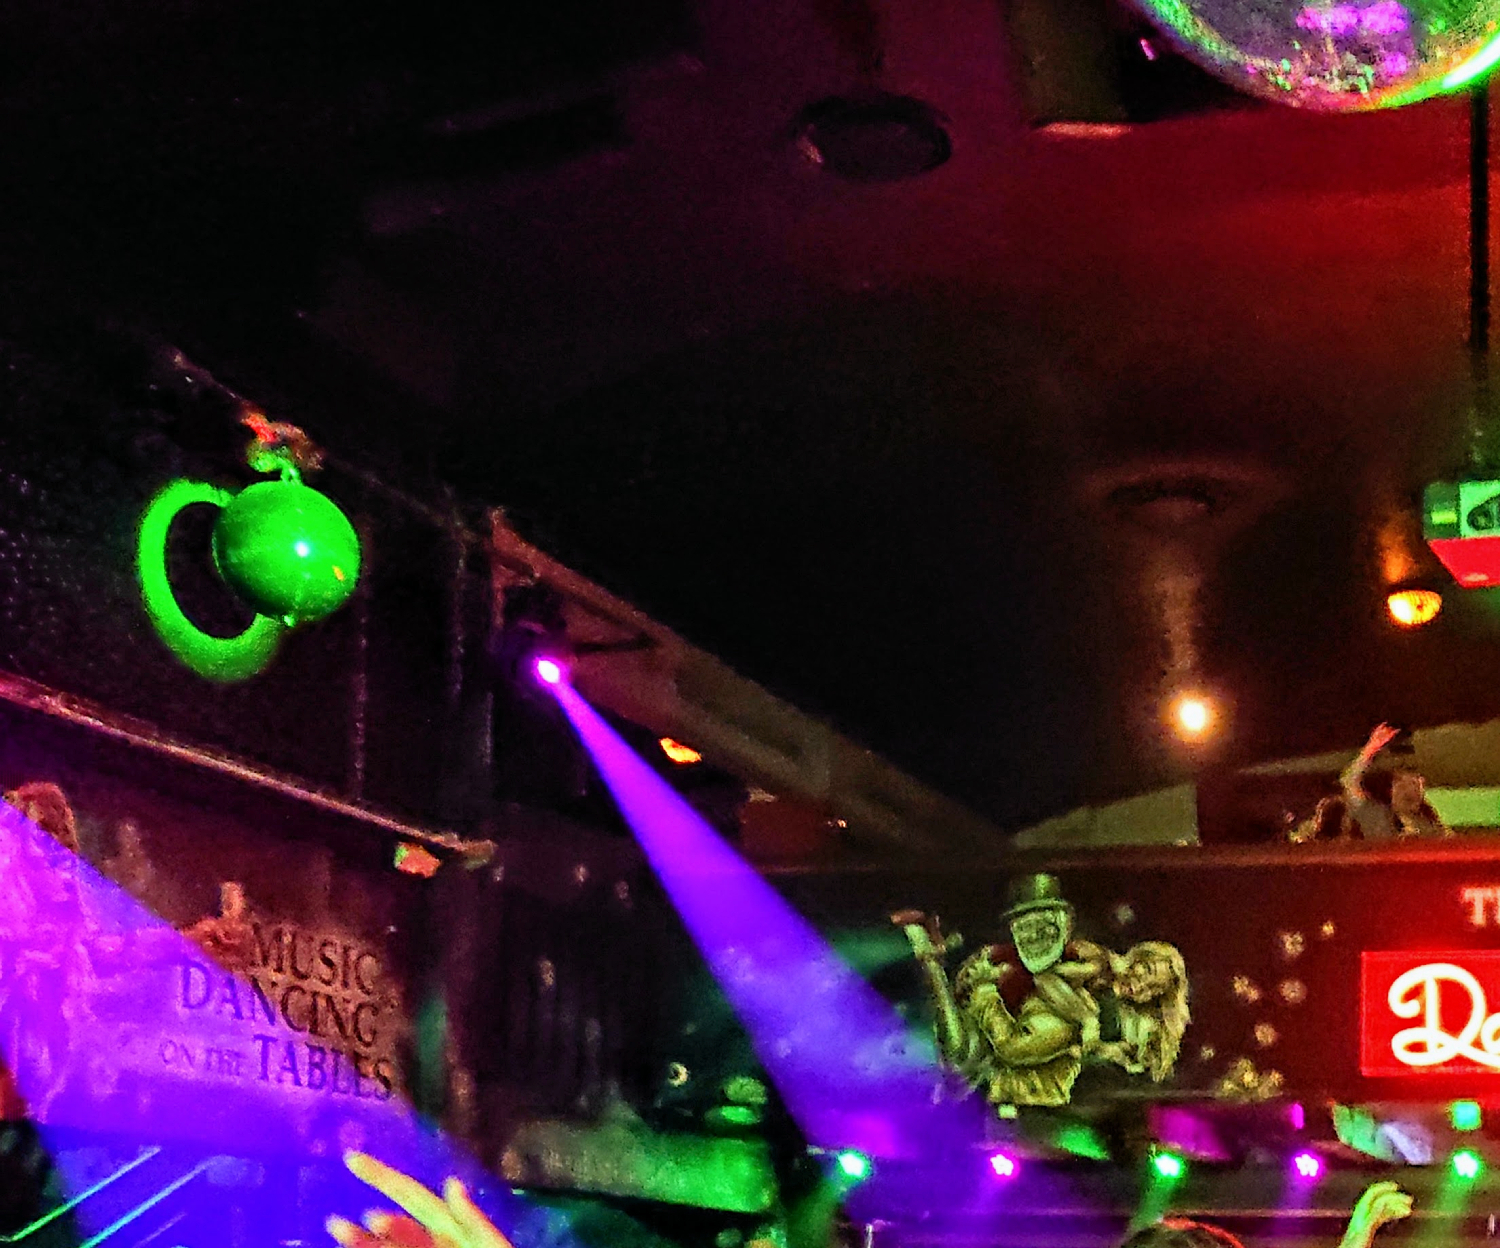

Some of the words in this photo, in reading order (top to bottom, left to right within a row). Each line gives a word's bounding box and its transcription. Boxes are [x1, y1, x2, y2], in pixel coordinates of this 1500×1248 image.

[250, 923, 378, 997] MUSIC
[180, 962, 379, 1048] DANCING
[159, 1040, 195, 1069] ON
[253, 1034, 393, 1101] TABLES
